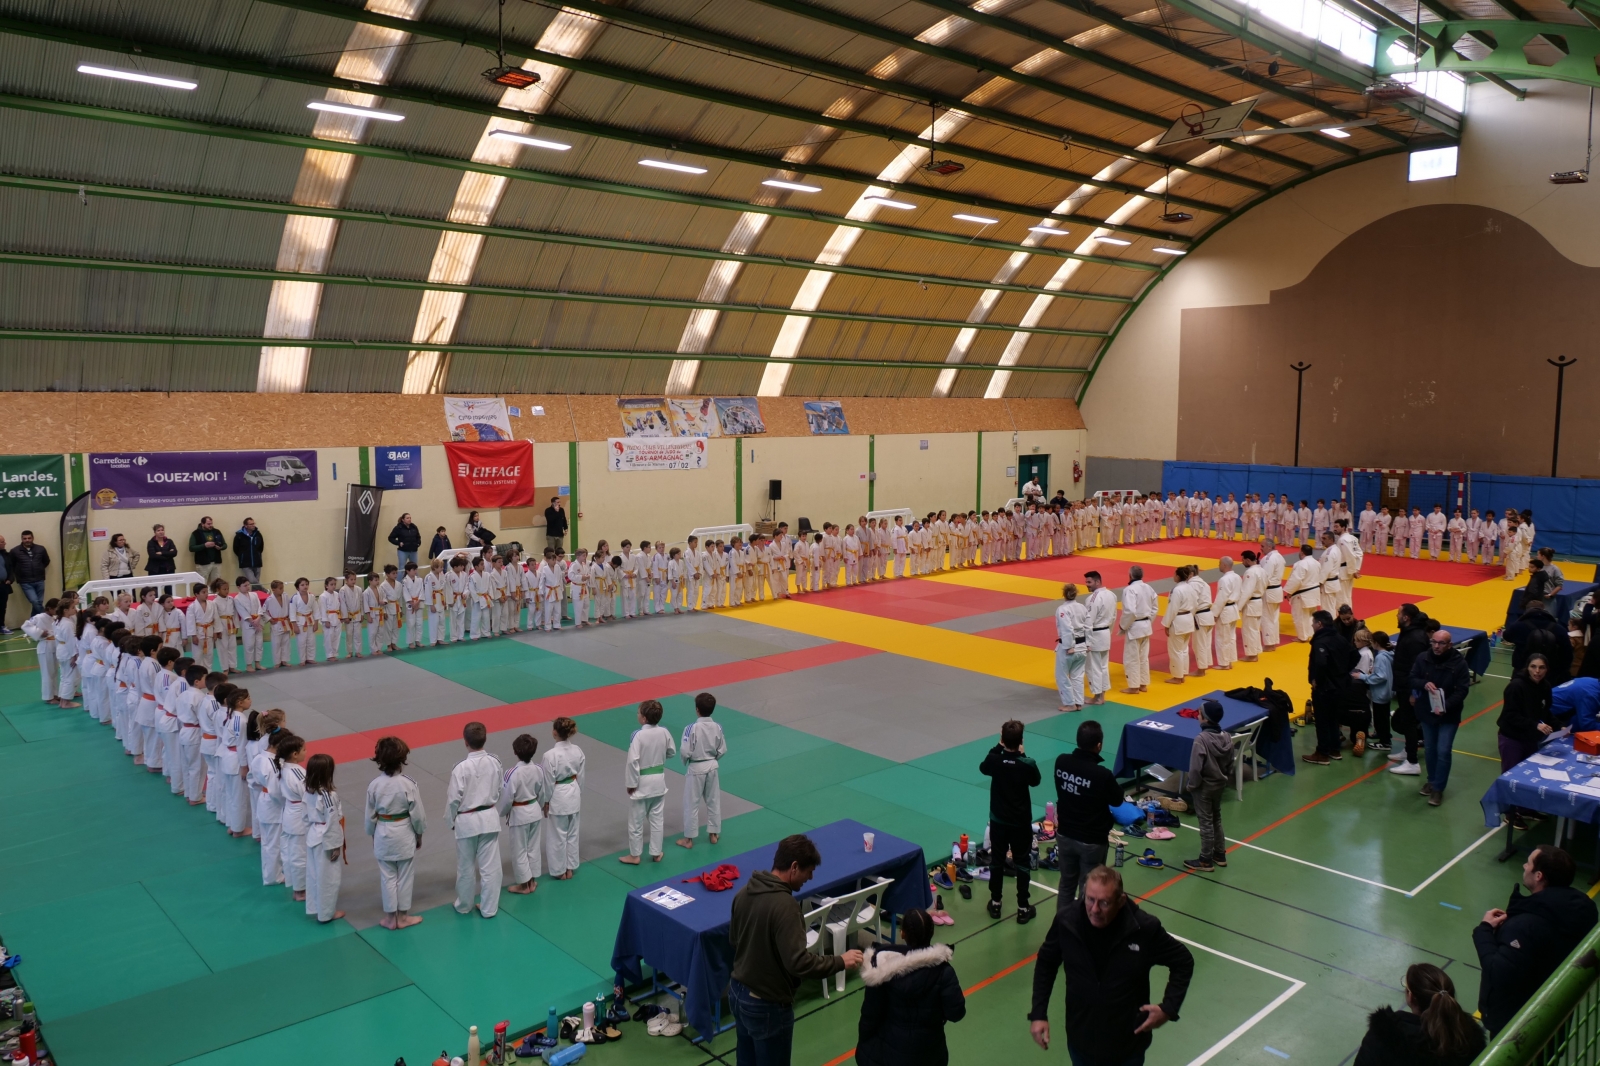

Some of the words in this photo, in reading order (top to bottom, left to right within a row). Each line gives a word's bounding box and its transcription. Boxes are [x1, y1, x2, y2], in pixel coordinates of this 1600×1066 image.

[2, 470, 57, 482] Landes,
[472, 466, 520, 478] EIFFAGE
[35, 486, 58, 497] XL.
[1056, 769, 1091, 788] COACH
[1061, 781, 1081, 796] JSL
